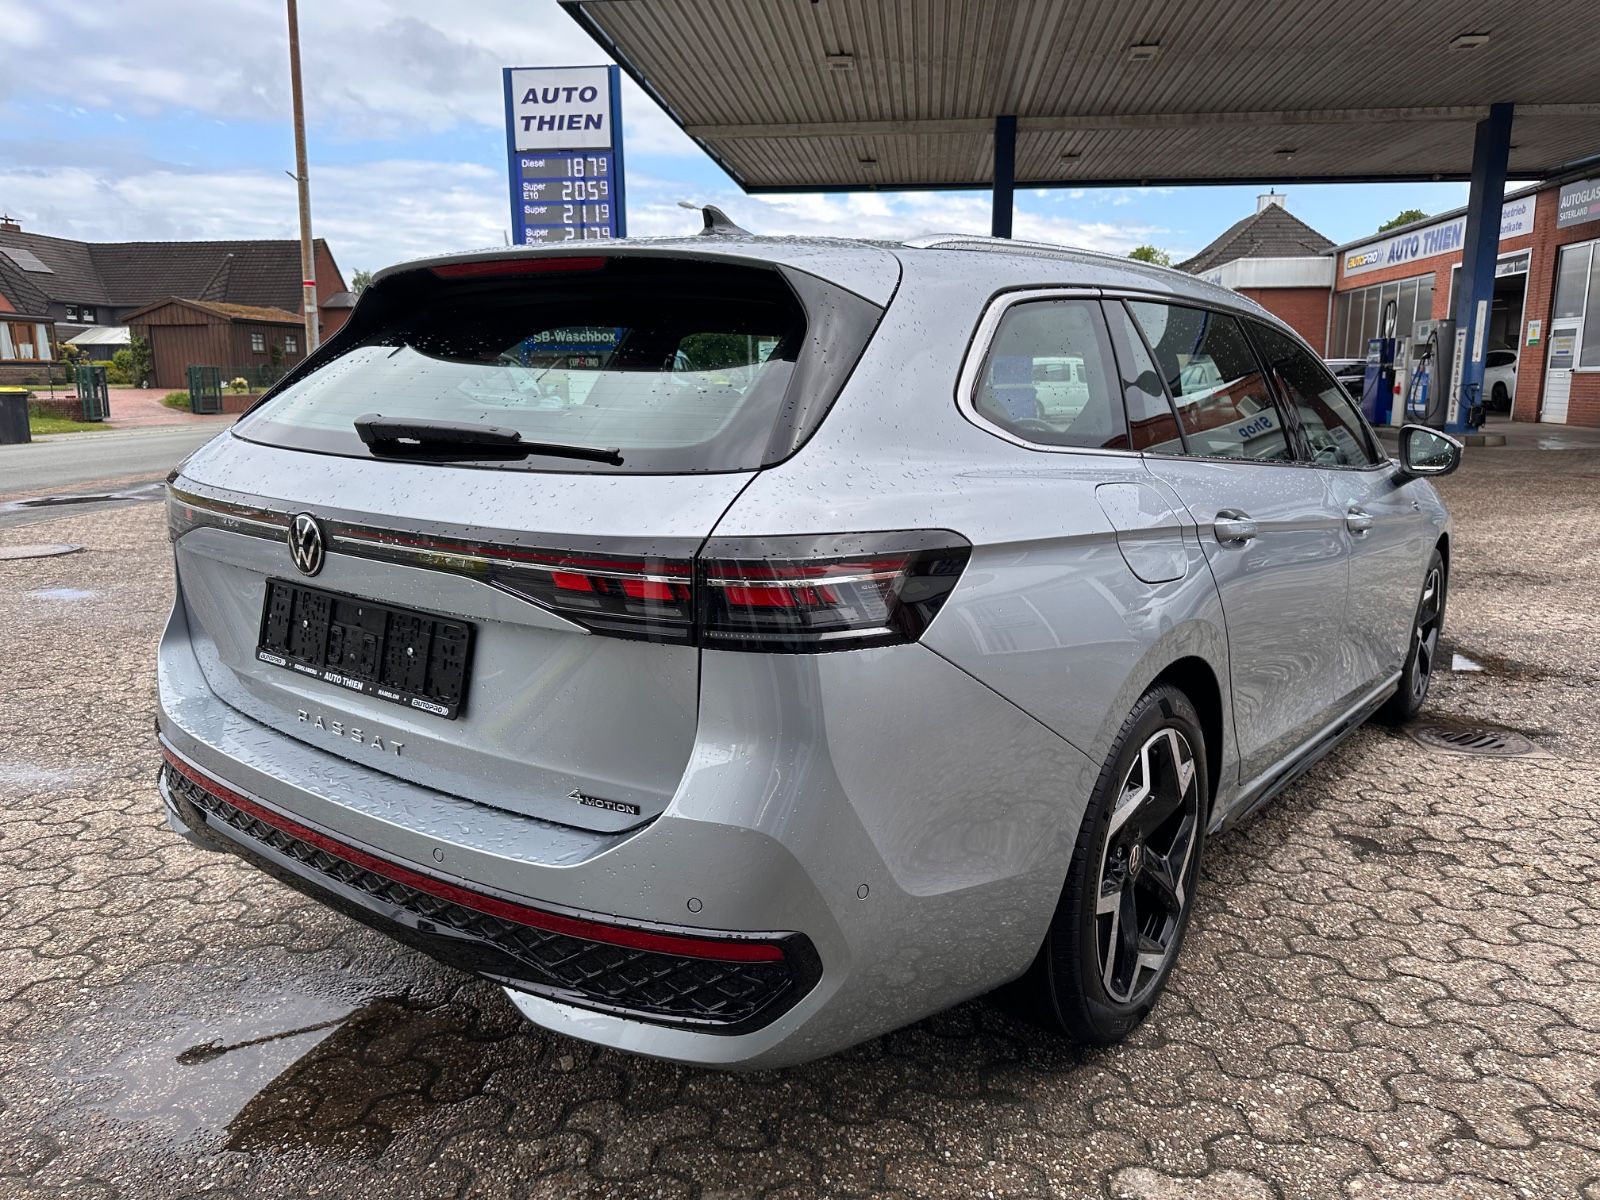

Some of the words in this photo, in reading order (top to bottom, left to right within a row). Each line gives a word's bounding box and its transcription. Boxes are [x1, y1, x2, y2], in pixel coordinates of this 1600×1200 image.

[521, 86, 598, 104] AUTO
[520, 114, 603, 131] THIEN
[521, 159, 546, 168] Diesel
[522, 182, 547, 192] Super
[523, 191, 539, 200] E10
[524, 204, 548, 215] Super
[1502, 204, 1527, 219] betrieb
[1559, 206, 1588, 221] SATERLAND
[525, 228, 549, 239] Super
[1500, 221, 1523, 234] brikate
[1386, 235, 1420, 264] AUTO
[1422, 222, 1463, 255] THIEN
[533, 330, 616, 343] SB-Waschbox
[323, 671, 342, 684] AUTO
[342, 677, 364, 691] THIEN
[297, 709, 405, 757] PASSAT
